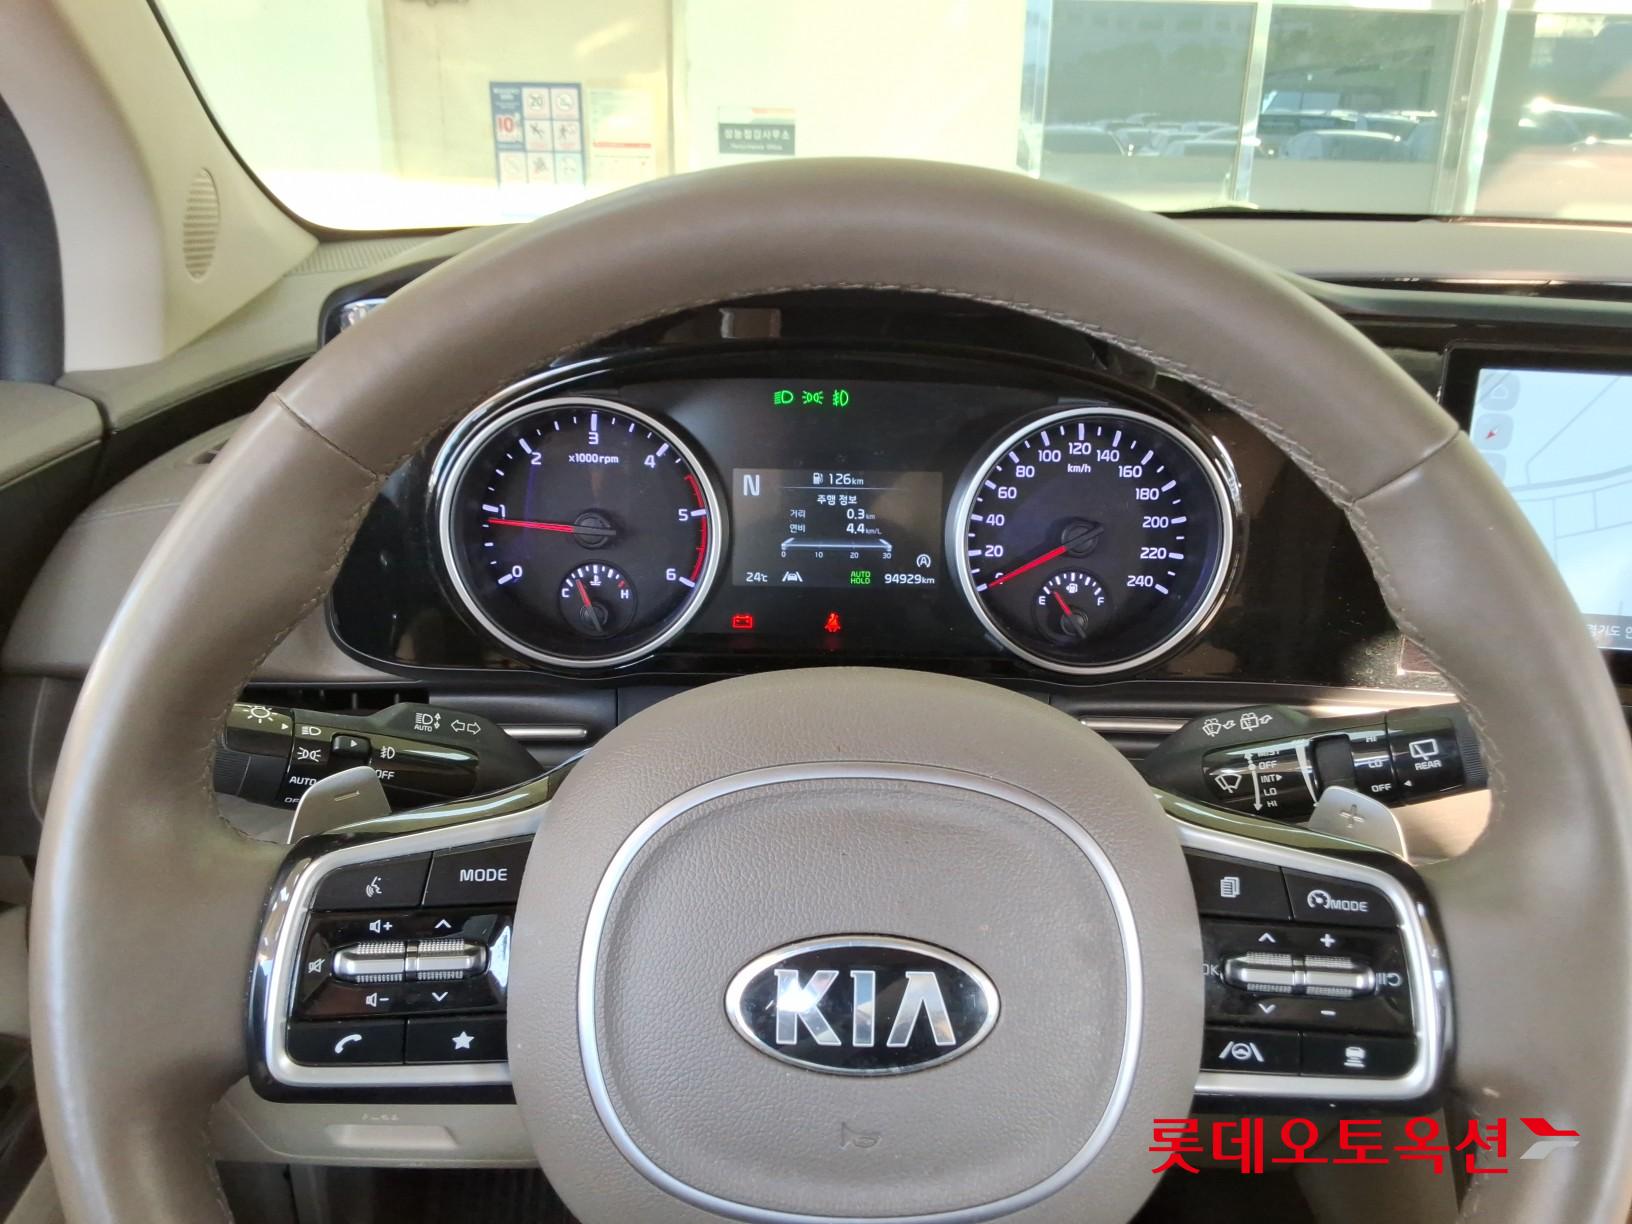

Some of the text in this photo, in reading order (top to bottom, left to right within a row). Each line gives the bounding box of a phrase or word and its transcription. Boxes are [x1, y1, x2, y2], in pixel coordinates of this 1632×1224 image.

[588, 432, 599, 445] 3
[1068, 442, 1091, 455] 120
[531, 452, 542, 465] 2
[644, 455, 656, 469] 4
[1038, 450, 1061, 462] 100
[1096, 450, 1120, 462] 140
[1015, 466, 1035, 478] 80
[1067, 463, 1091, 473] km/h
[1118, 465, 1142, 478] 160
[743, 474, 760, 496] N
[998, 486, 1017, 499] 60
[1135, 487, 1159, 500] 180
[817, 494, 858, 506] 주행 정보
[499, 504, 506, 518] 1
[678, 508, 688, 521] 5
[790, 509, 806, 519] 거리
[986, 514, 1005, 526] 40
[1142, 516, 1169, 528] 200
[789, 523, 806, 533] 연비
[815, 551, 824, 559] 10
[882, 552, 892, 560] 30
[984, 545, 1004, 557] 20
[1140, 547, 1167, 560] 220
[512, 565, 523, 578] 0
[665, 568, 676, 581] 6
[850, 577, 871, 585] HOLD
[1127, 576, 1154, 587] 240
[561, 588, 570, 598] C
[620, 589, 629, 599] H
[1038, 596, 1046, 605] E
[1097, 597, 1105, 606] F
[414, 724, 433, 732] AUTO
[1258, 760, 1278, 770] OFF
[1368, 759, 1383, 768] LO
[1414, 759, 1442, 771] REAR
[289, 776, 317, 786] AUTO
[1260, 774, 1275, 783] INT
[1263, 787, 1278, 796] LO
[1371, 783, 1392, 793] OFF
[1266, 800, 1278, 808] HI
[459, 868, 508, 882] MODE
[1330, 899, 1369, 912] MODE
[1201, 963, 1219, 976] OK
[773, 969, 957, 1047] KIA
